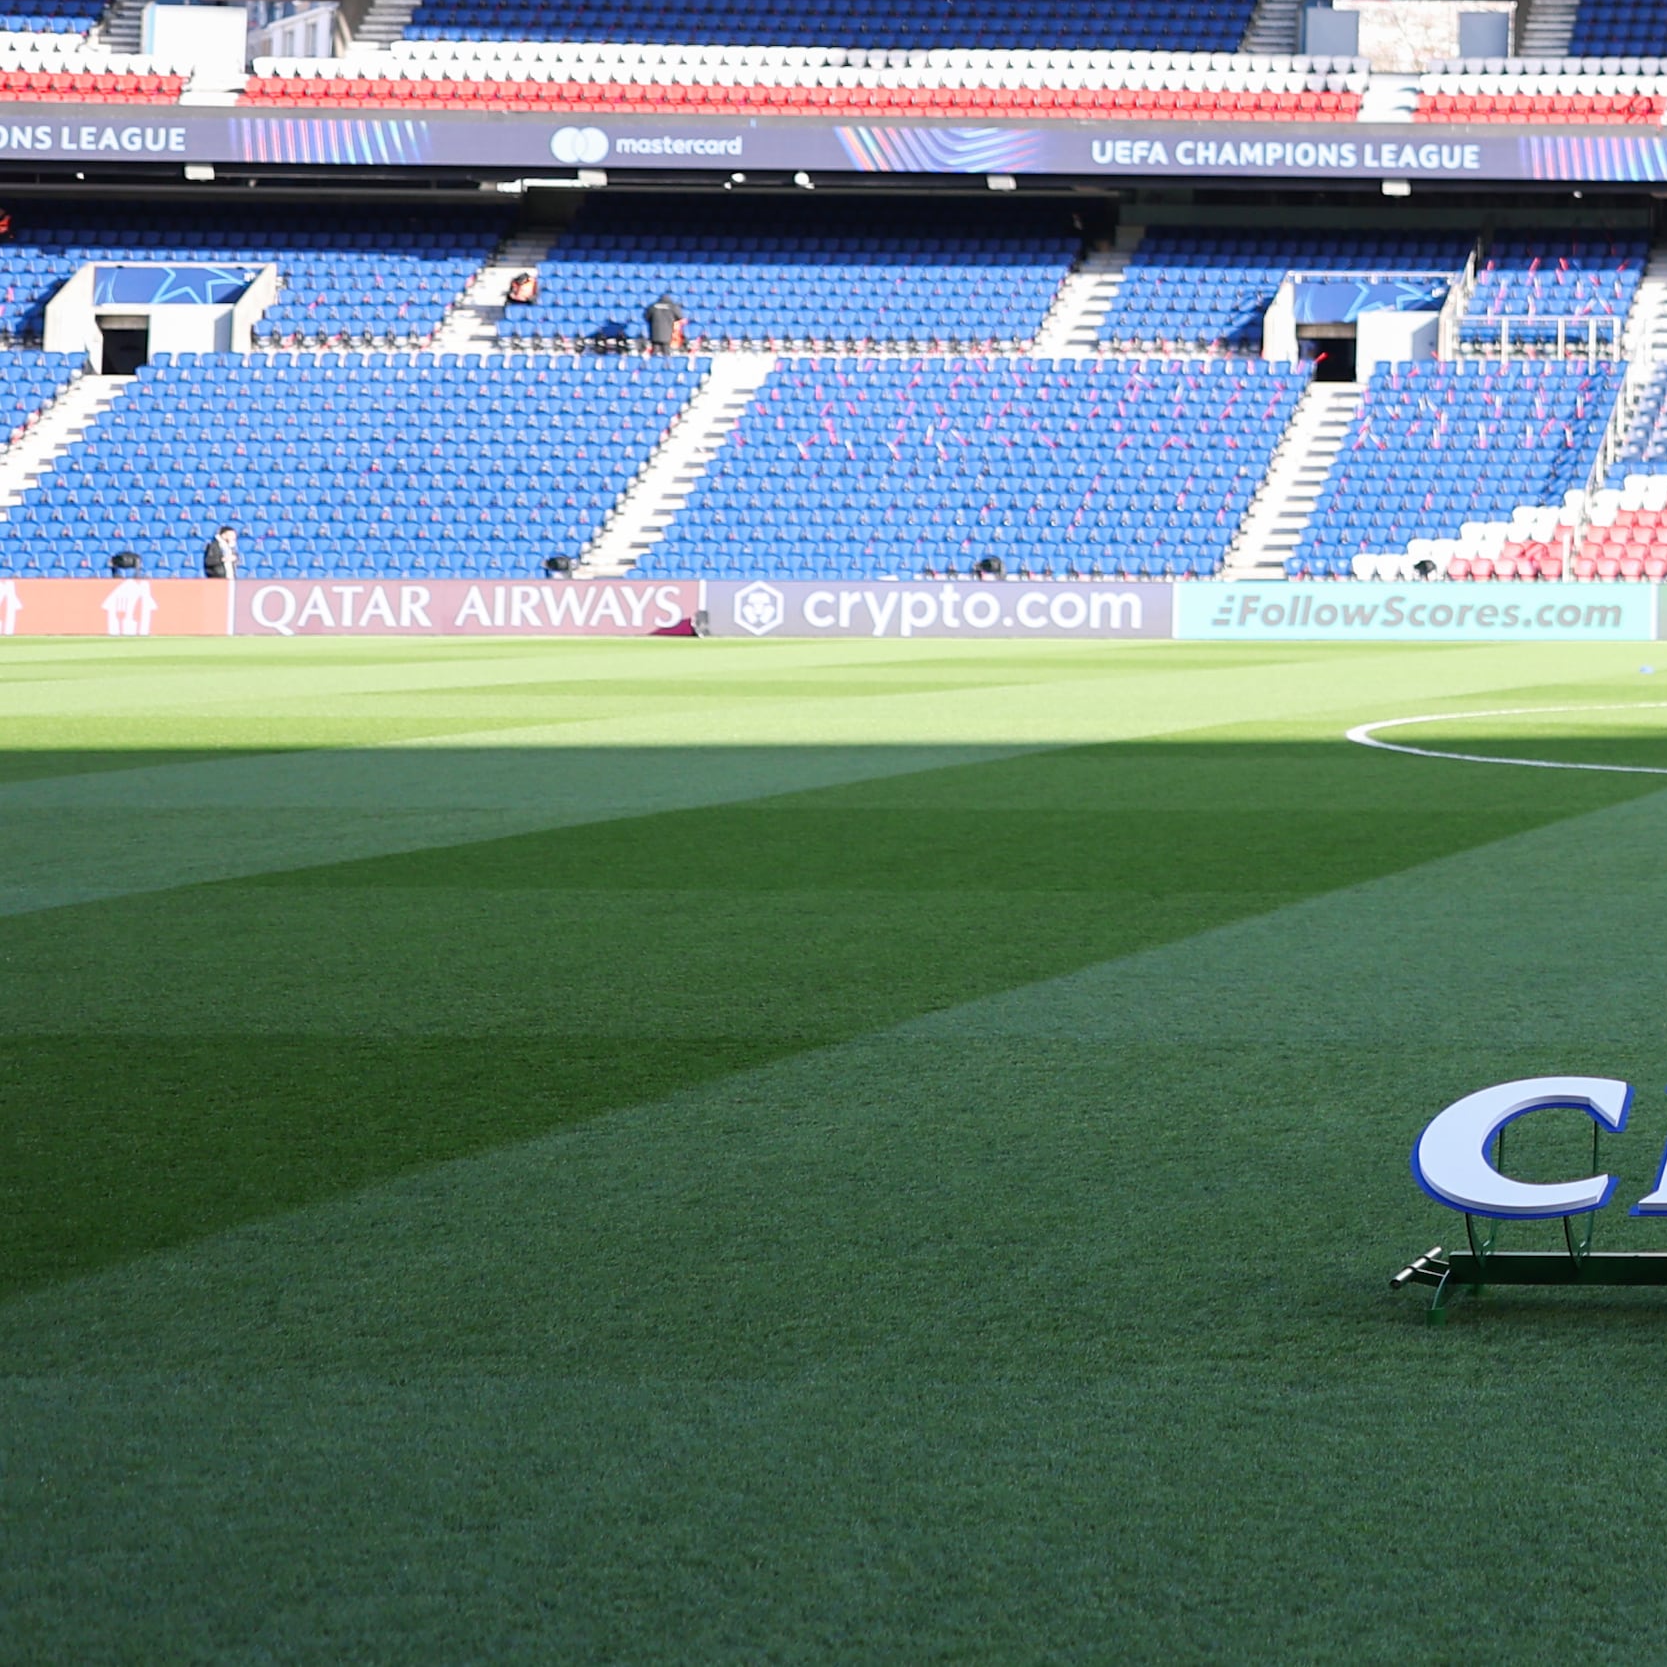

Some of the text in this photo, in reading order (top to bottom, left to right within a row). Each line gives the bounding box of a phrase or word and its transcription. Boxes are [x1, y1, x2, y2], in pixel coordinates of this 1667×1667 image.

[61, 126, 186, 152] LEAGUE
[616, 134, 743, 157] mastercard
[1092, 140, 1480, 170] UEFA CHAMPIONS LEAGUE
[251, 584, 684, 635] QATAR AIRWAYS
[803, 583, 1142, 636] crypto.com
